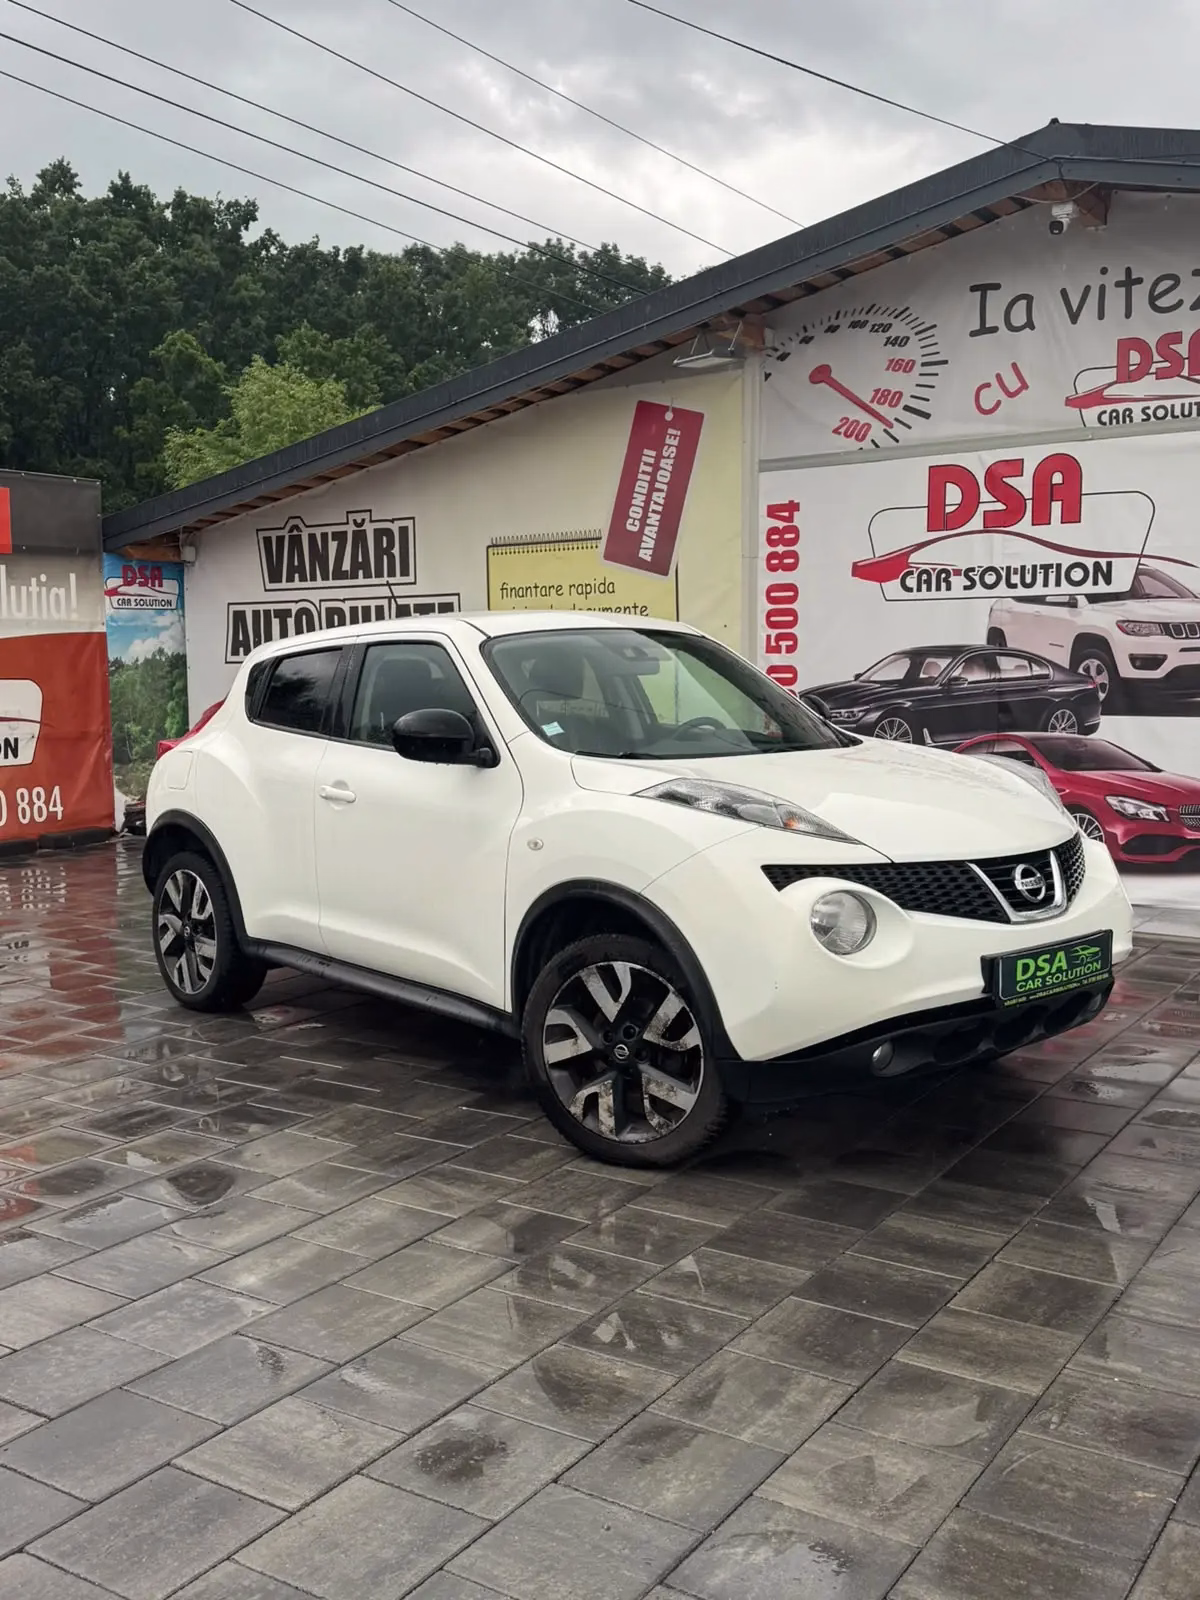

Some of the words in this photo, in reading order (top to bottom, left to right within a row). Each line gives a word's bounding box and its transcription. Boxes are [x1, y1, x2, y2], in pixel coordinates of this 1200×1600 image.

[969, 282, 1036, 337] Ia
[869, 323, 893, 333] 120
[883, 336, 910, 348] 140
[885, 357, 916, 374] 160
[868, 387, 903, 408] 180
[974, 361, 1030, 416] cu
[832, 416, 872, 442] 200
[1097, 407, 1134, 426] CAR
[625, 448, 657, 533] CONDITII
[638, 427, 681, 562] AVANTAJOASE!
[926, 453, 1083, 532] DSA
[262, 518, 410, 584] VÂNZĂRI
[765, 500, 800, 573] 884
[122, 564, 163, 588] DSA
[499, 581, 564, 600] finantare
[568, 576, 615, 600] rapida
[899, 568, 952, 593] CAR
[963, 560, 1113, 591] SOLUTION
[116, 598, 132, 607] CAR
[134, 598, 173, 608] SOLUTION
[765, 583, 799, 655] 500
[0, 737, 19, 759] N
[16, 785, 64, 825] 884
[1016, 950, 1068, 981] DSA
[1016, 977, 1042, 992] CAR
[1045, 960, 1101, 985] SOLUTION
